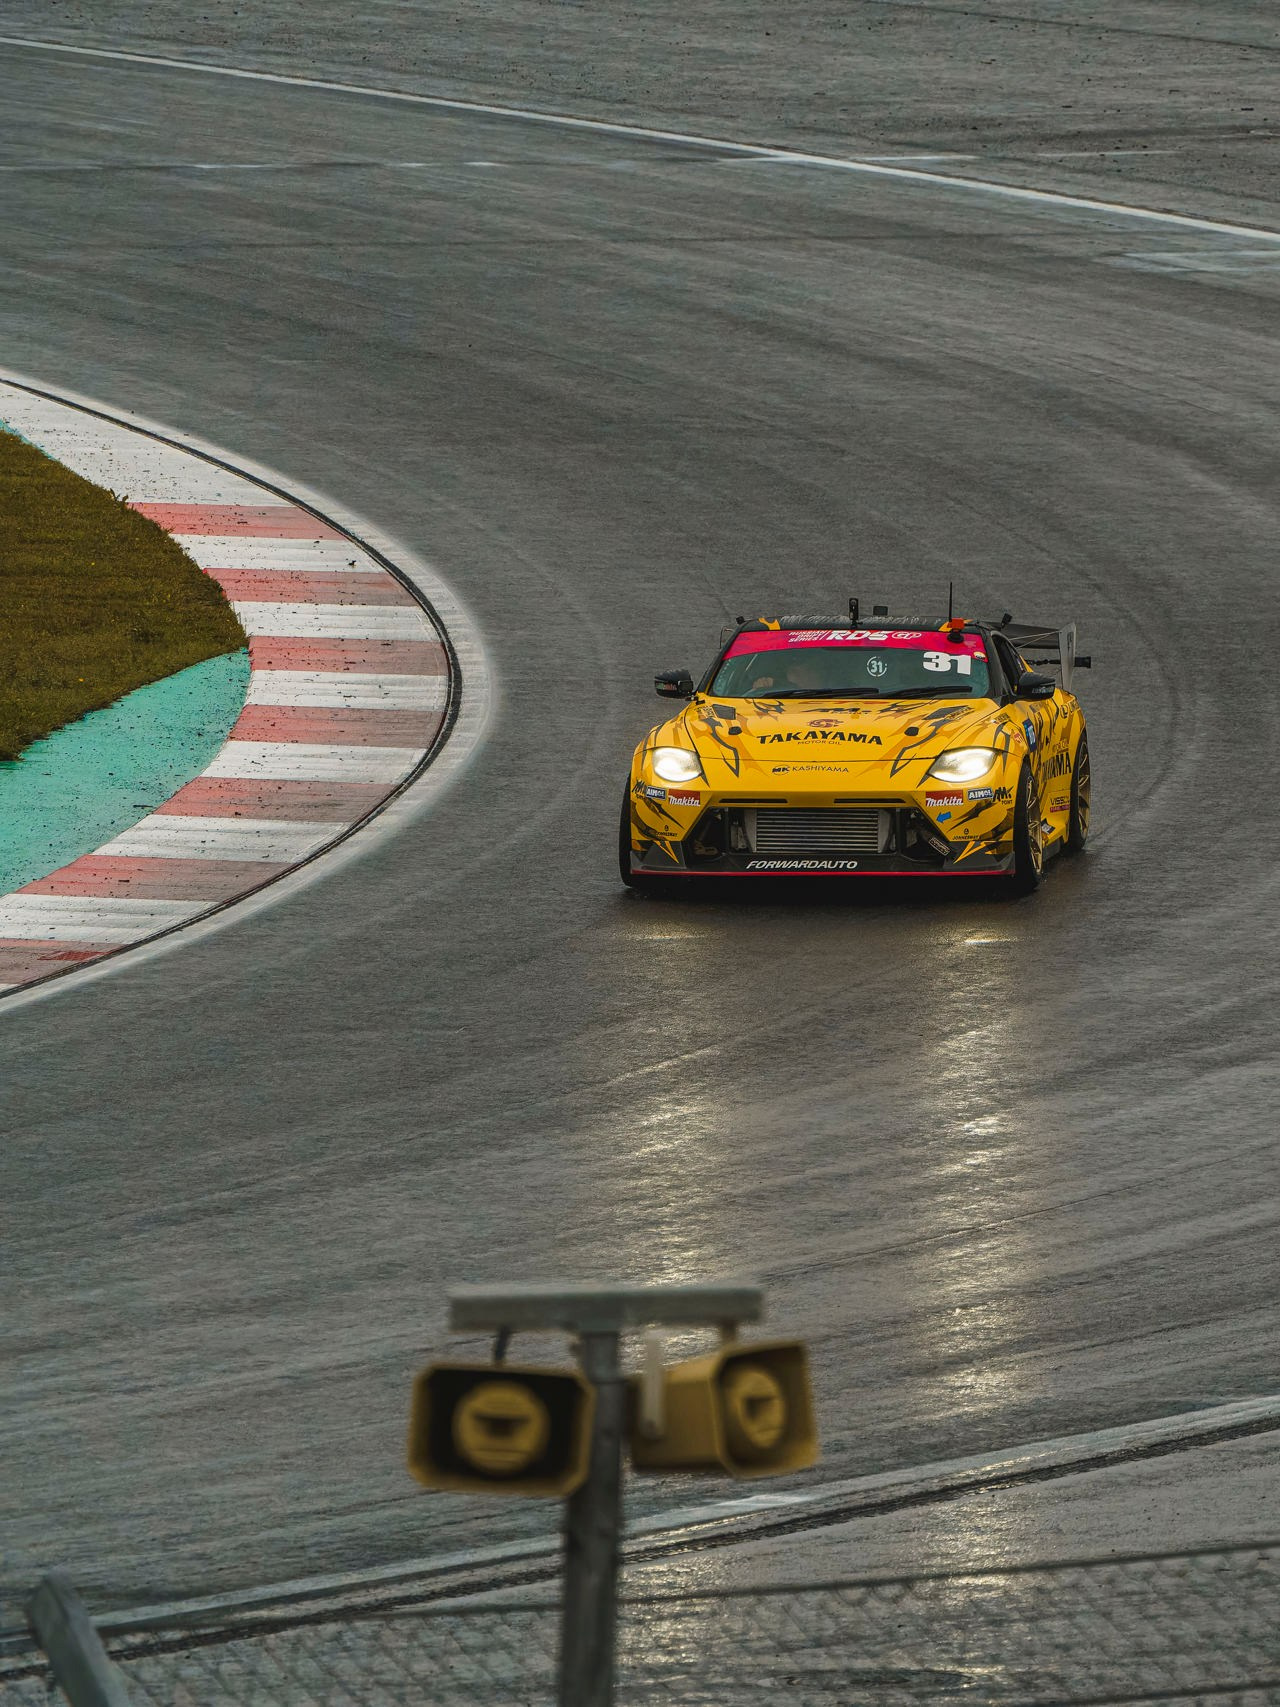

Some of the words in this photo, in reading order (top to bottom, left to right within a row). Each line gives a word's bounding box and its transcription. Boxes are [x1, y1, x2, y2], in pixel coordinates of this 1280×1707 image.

[826, 630, 893, 641] RDS
[870, 660, 883, 673] 31
[923, 651, 972, 676] 31
[757, 730, 883, 746] TAKAYAMA
[792, 765, 850, 773] KASHIYAMA
[745, 860, 858, 870] FORWARDAUTO
